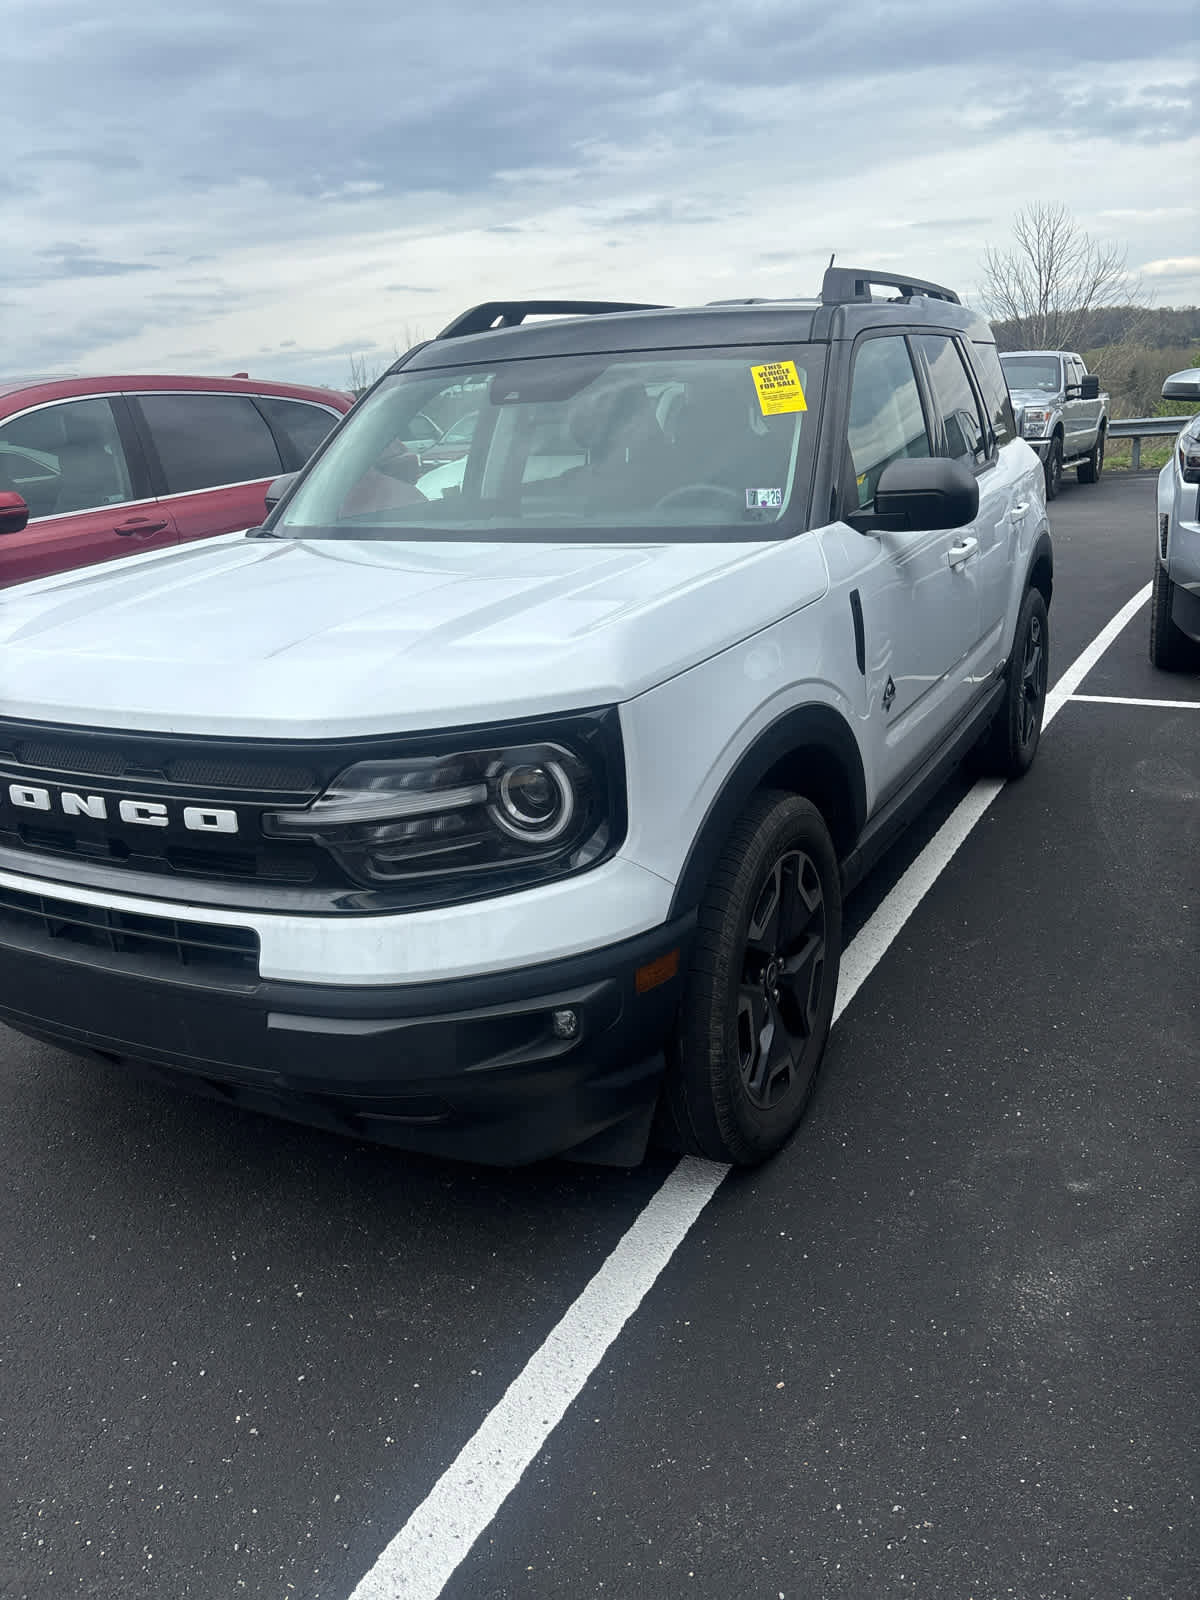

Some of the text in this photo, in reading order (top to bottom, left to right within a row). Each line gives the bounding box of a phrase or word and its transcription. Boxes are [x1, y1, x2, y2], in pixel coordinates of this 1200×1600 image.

[758, 368, 790, 378] VEHICLE
[759, 379, 795, 390] FOR SALE
[771, 490, 780, 504] 26
[8, 784, 239, 833] ONCO
